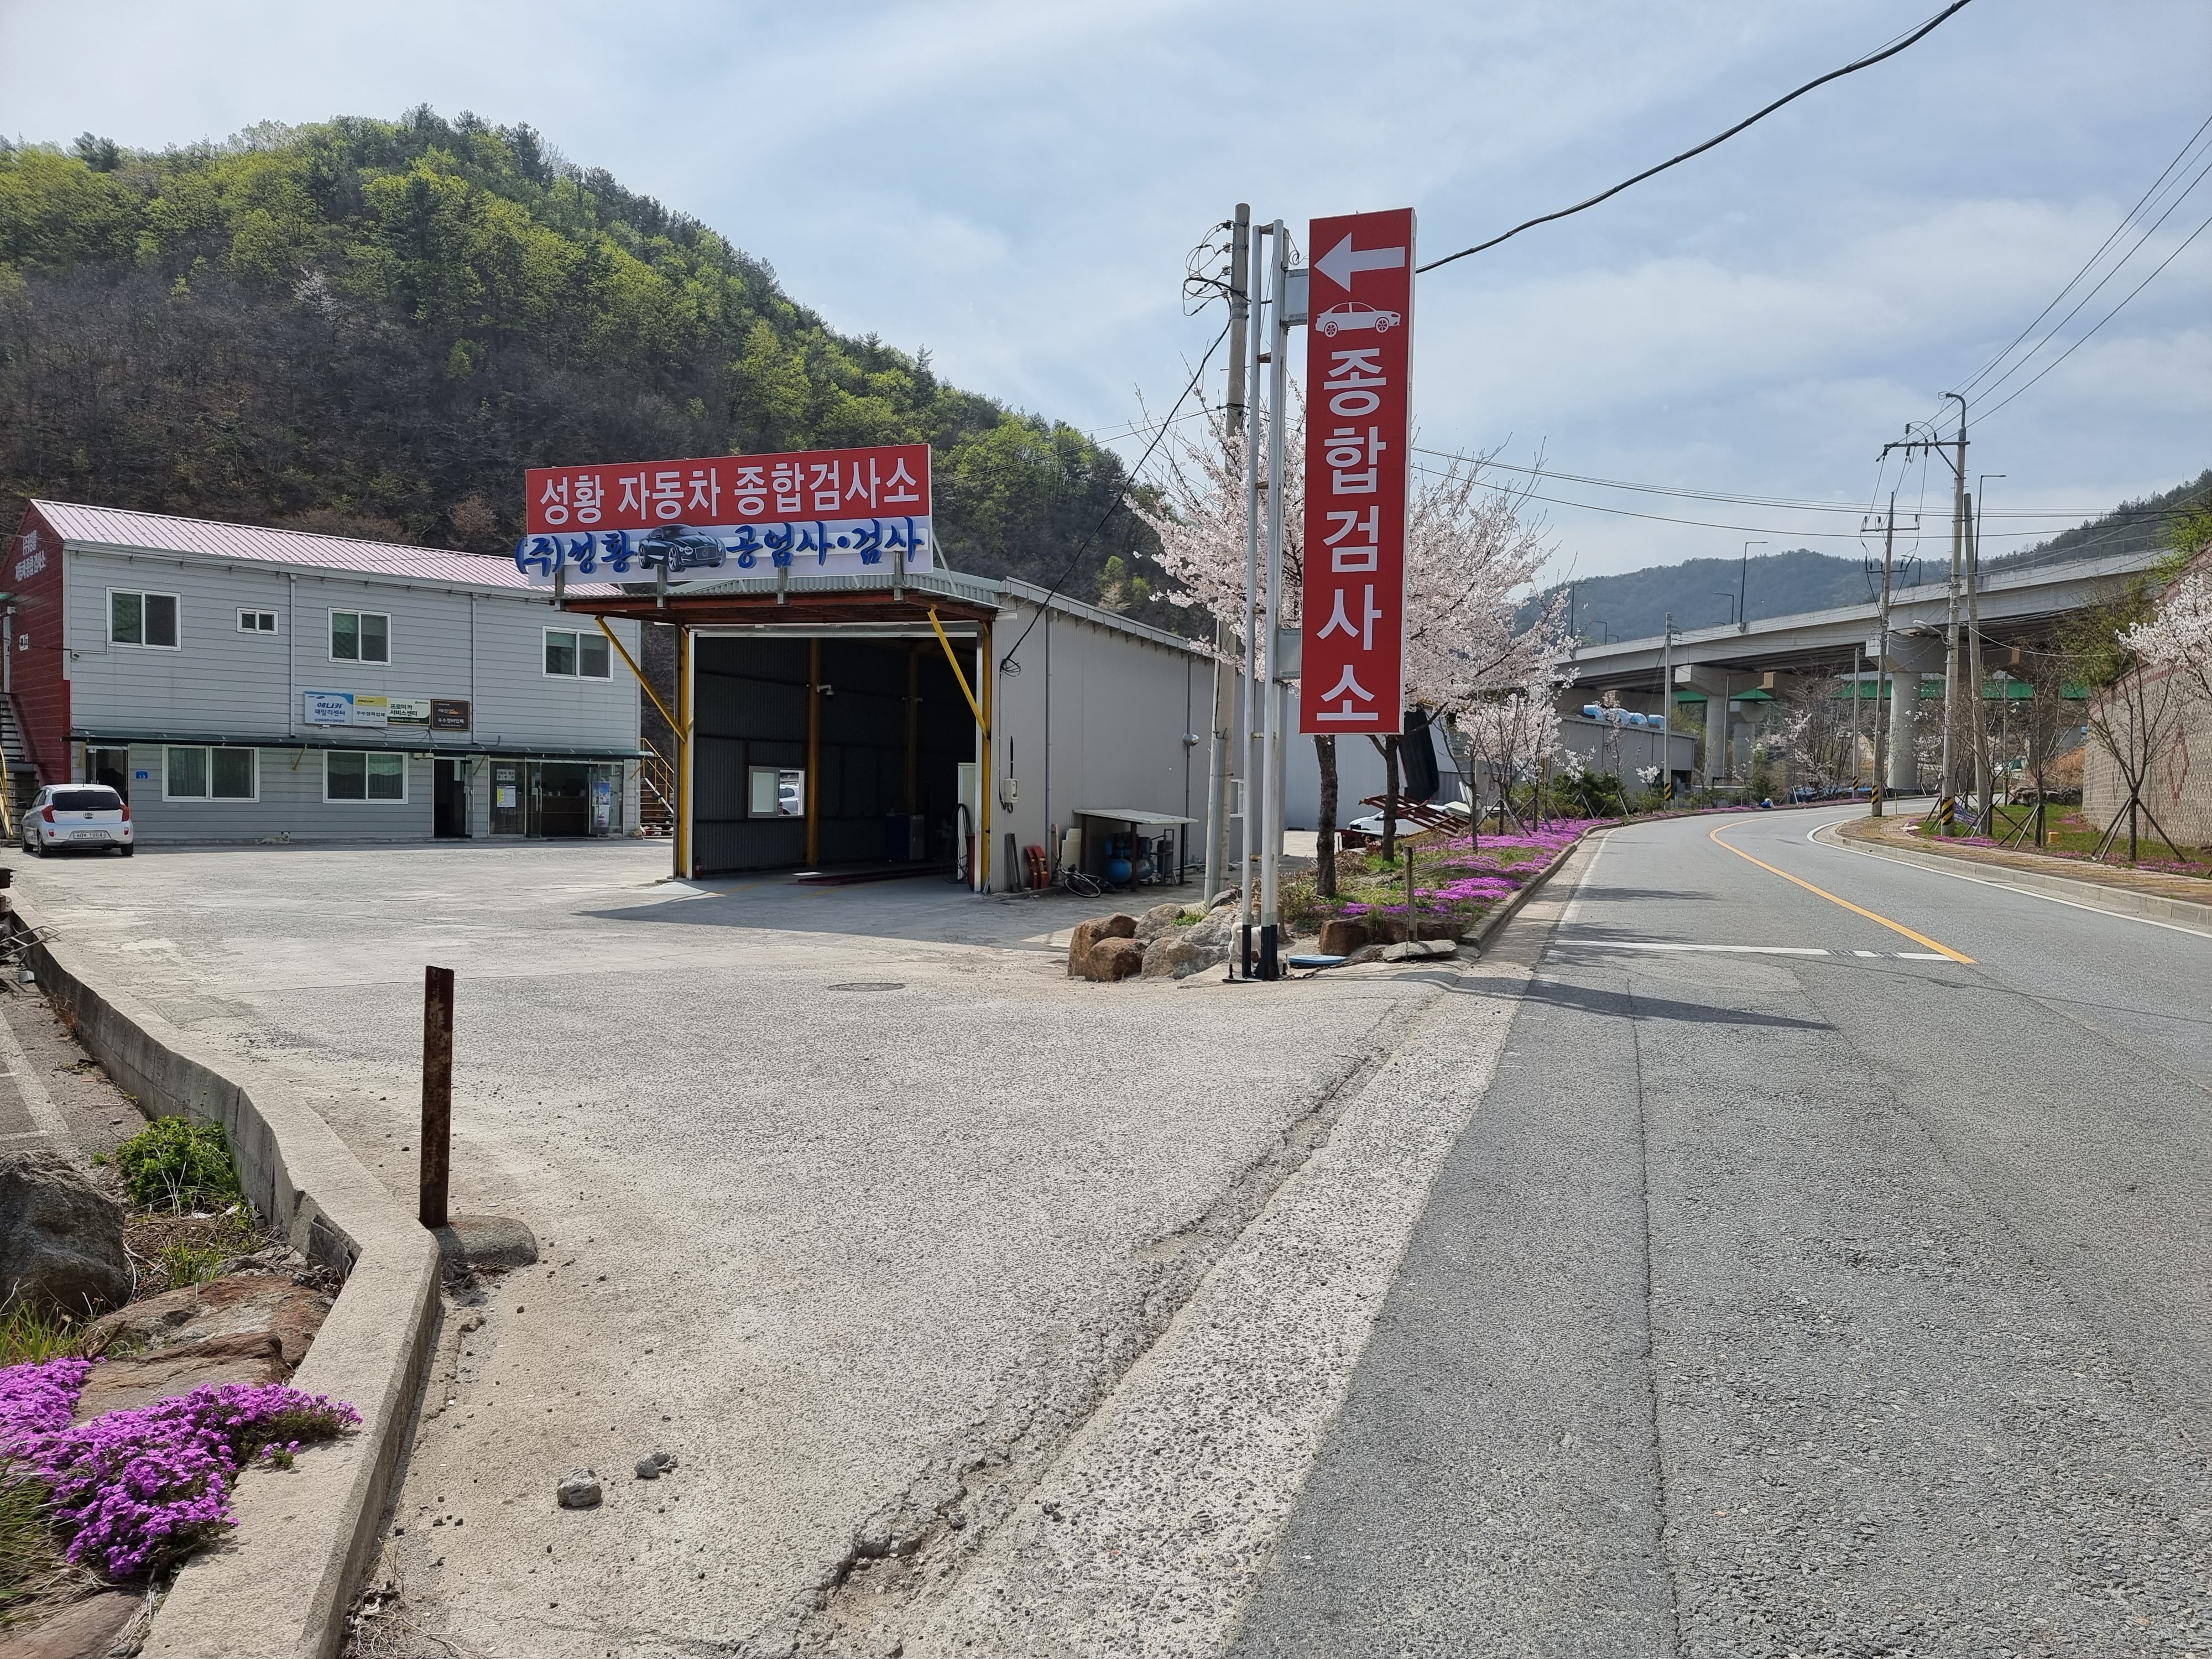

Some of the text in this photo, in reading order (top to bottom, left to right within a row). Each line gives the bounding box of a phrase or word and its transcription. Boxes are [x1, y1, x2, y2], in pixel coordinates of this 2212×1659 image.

[540, 457, 920, 525] 성황 자동차 종합검사소
[515, 529, 638, 578] (주)성황
[1317, 348, 1386, 721] 종합검사소
